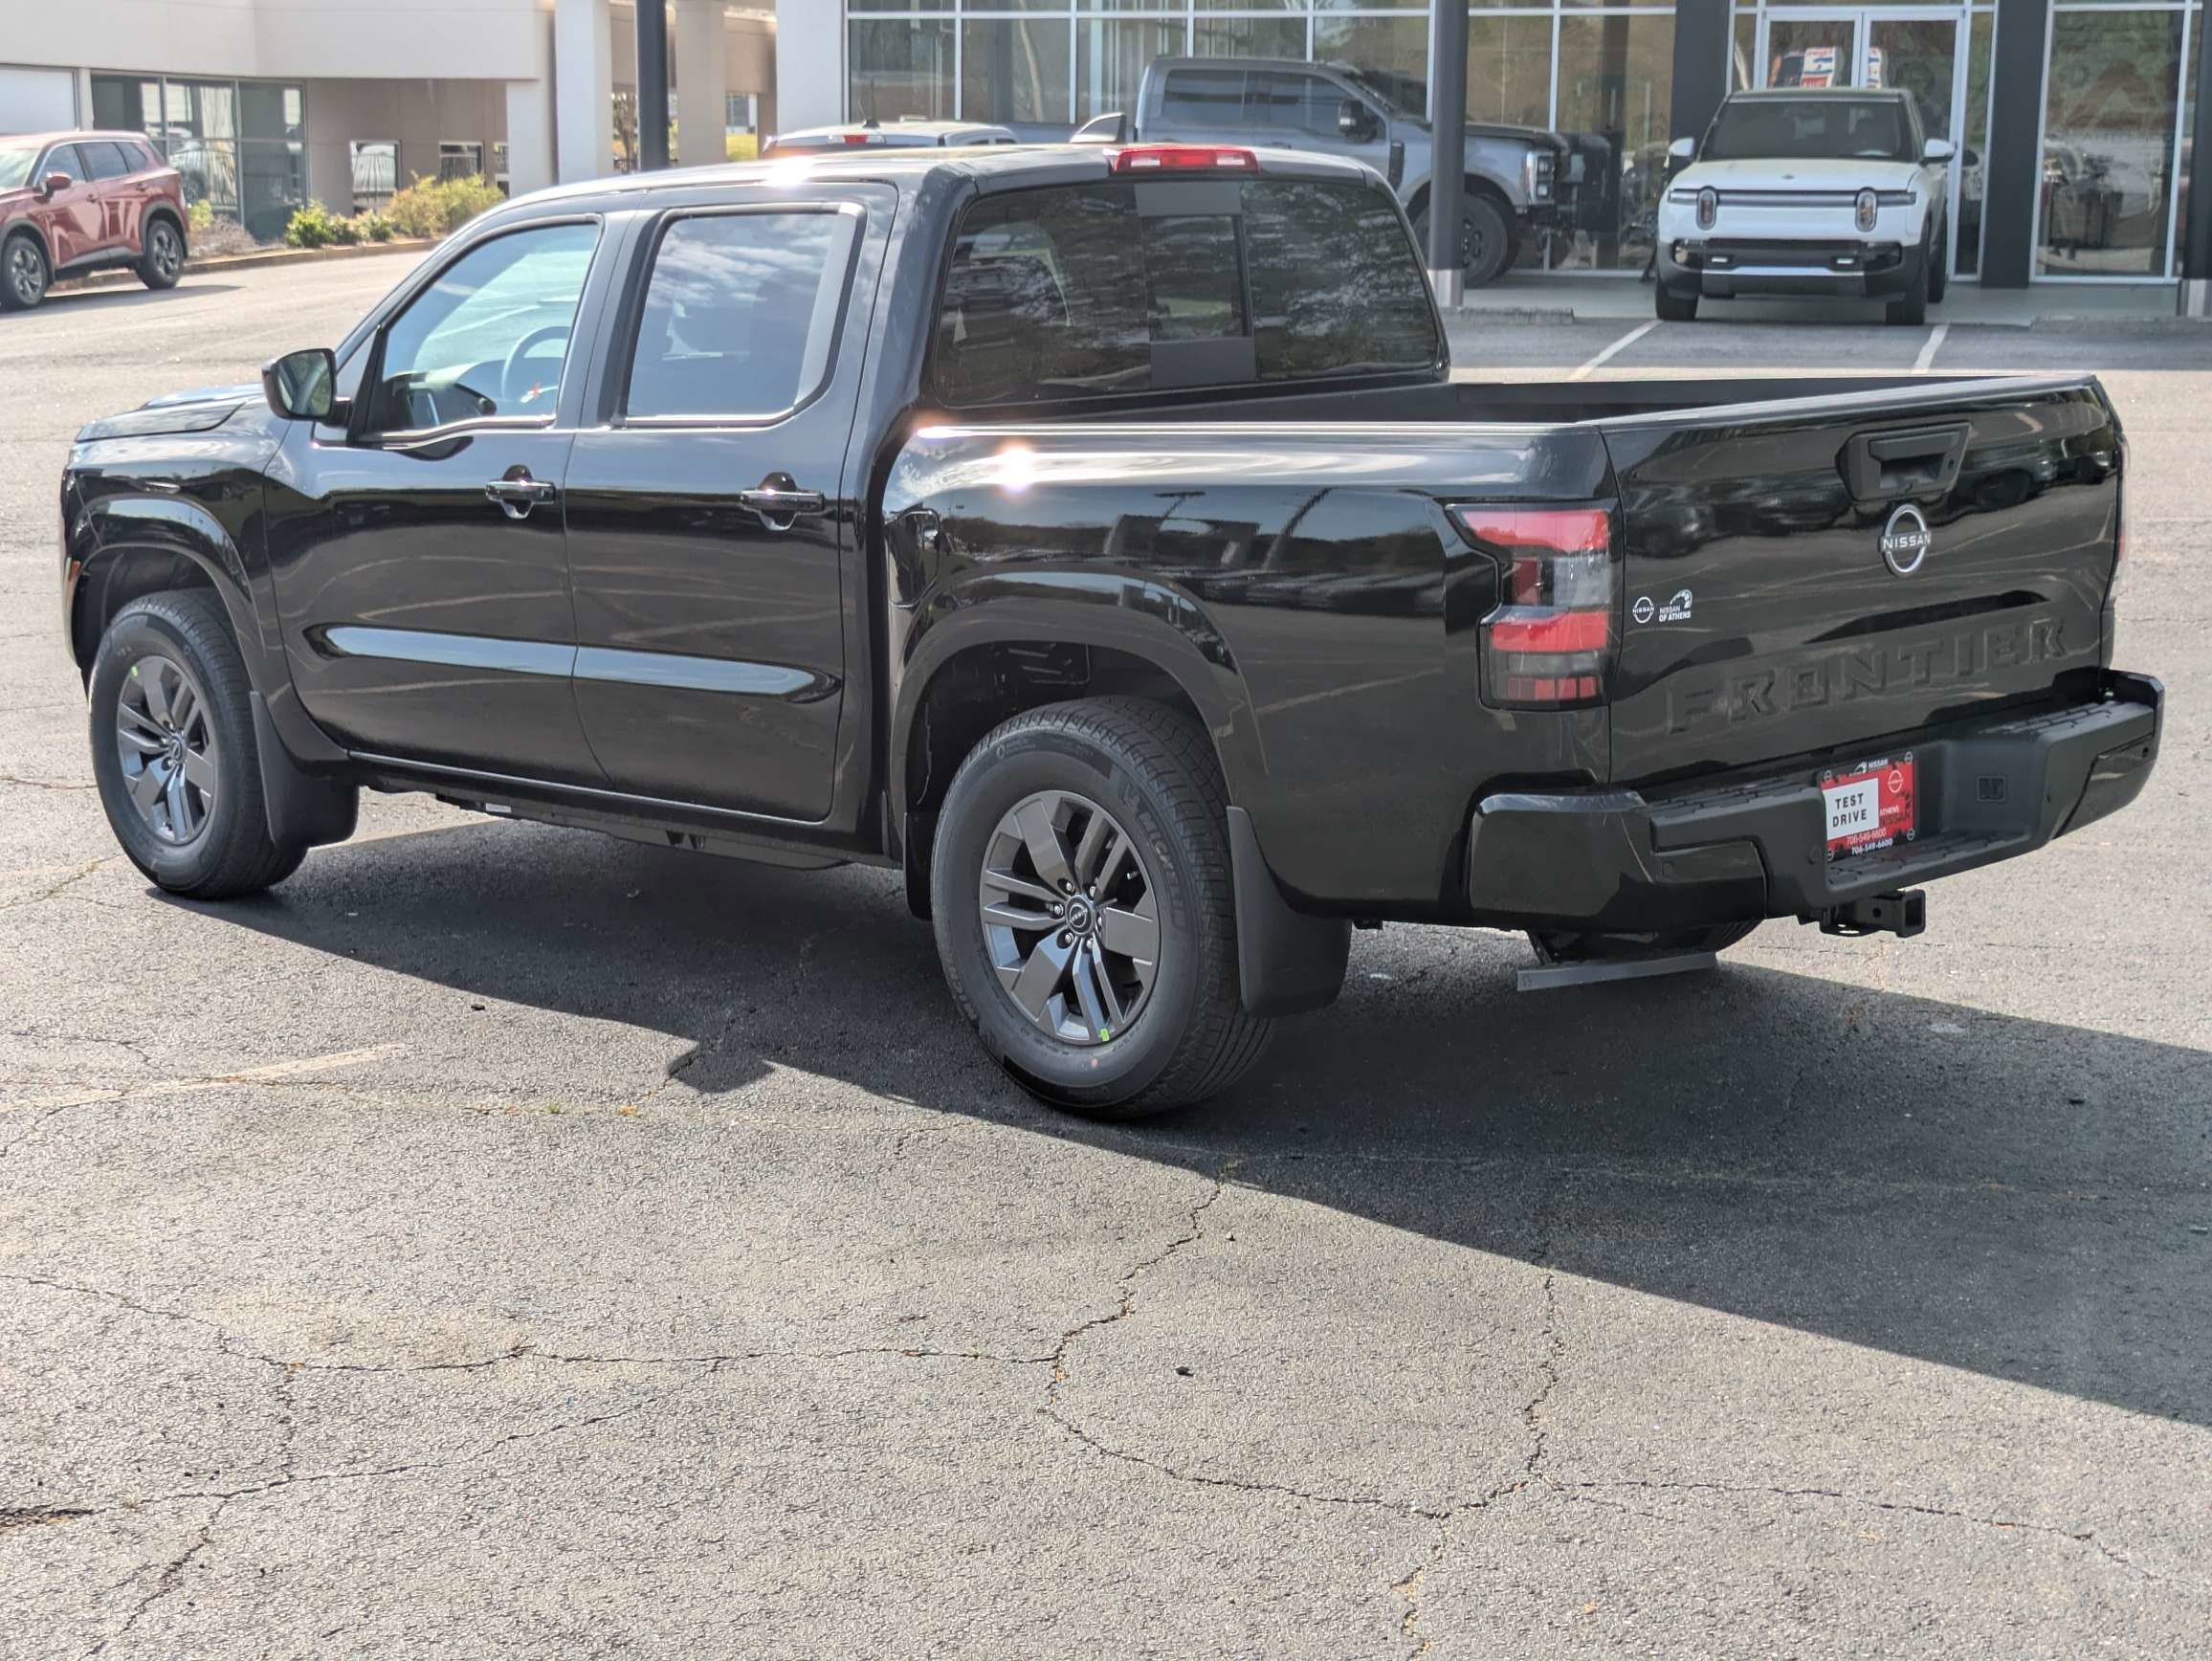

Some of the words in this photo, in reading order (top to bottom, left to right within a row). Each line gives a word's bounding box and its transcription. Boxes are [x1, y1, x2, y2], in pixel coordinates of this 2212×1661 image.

[1882, 531, 1931, 549] NISSAN
[1658, 614, 1668, 623] OF
[1668, 610, 1692, 621] ATHENS
[1659, 605, 1681, 614] NISSAN
[1667, 617, 2067, 735] FRONTIER
[1835, 792, 1864, 809] TEST
[1832, 808, 1868, 828] DRIVE
